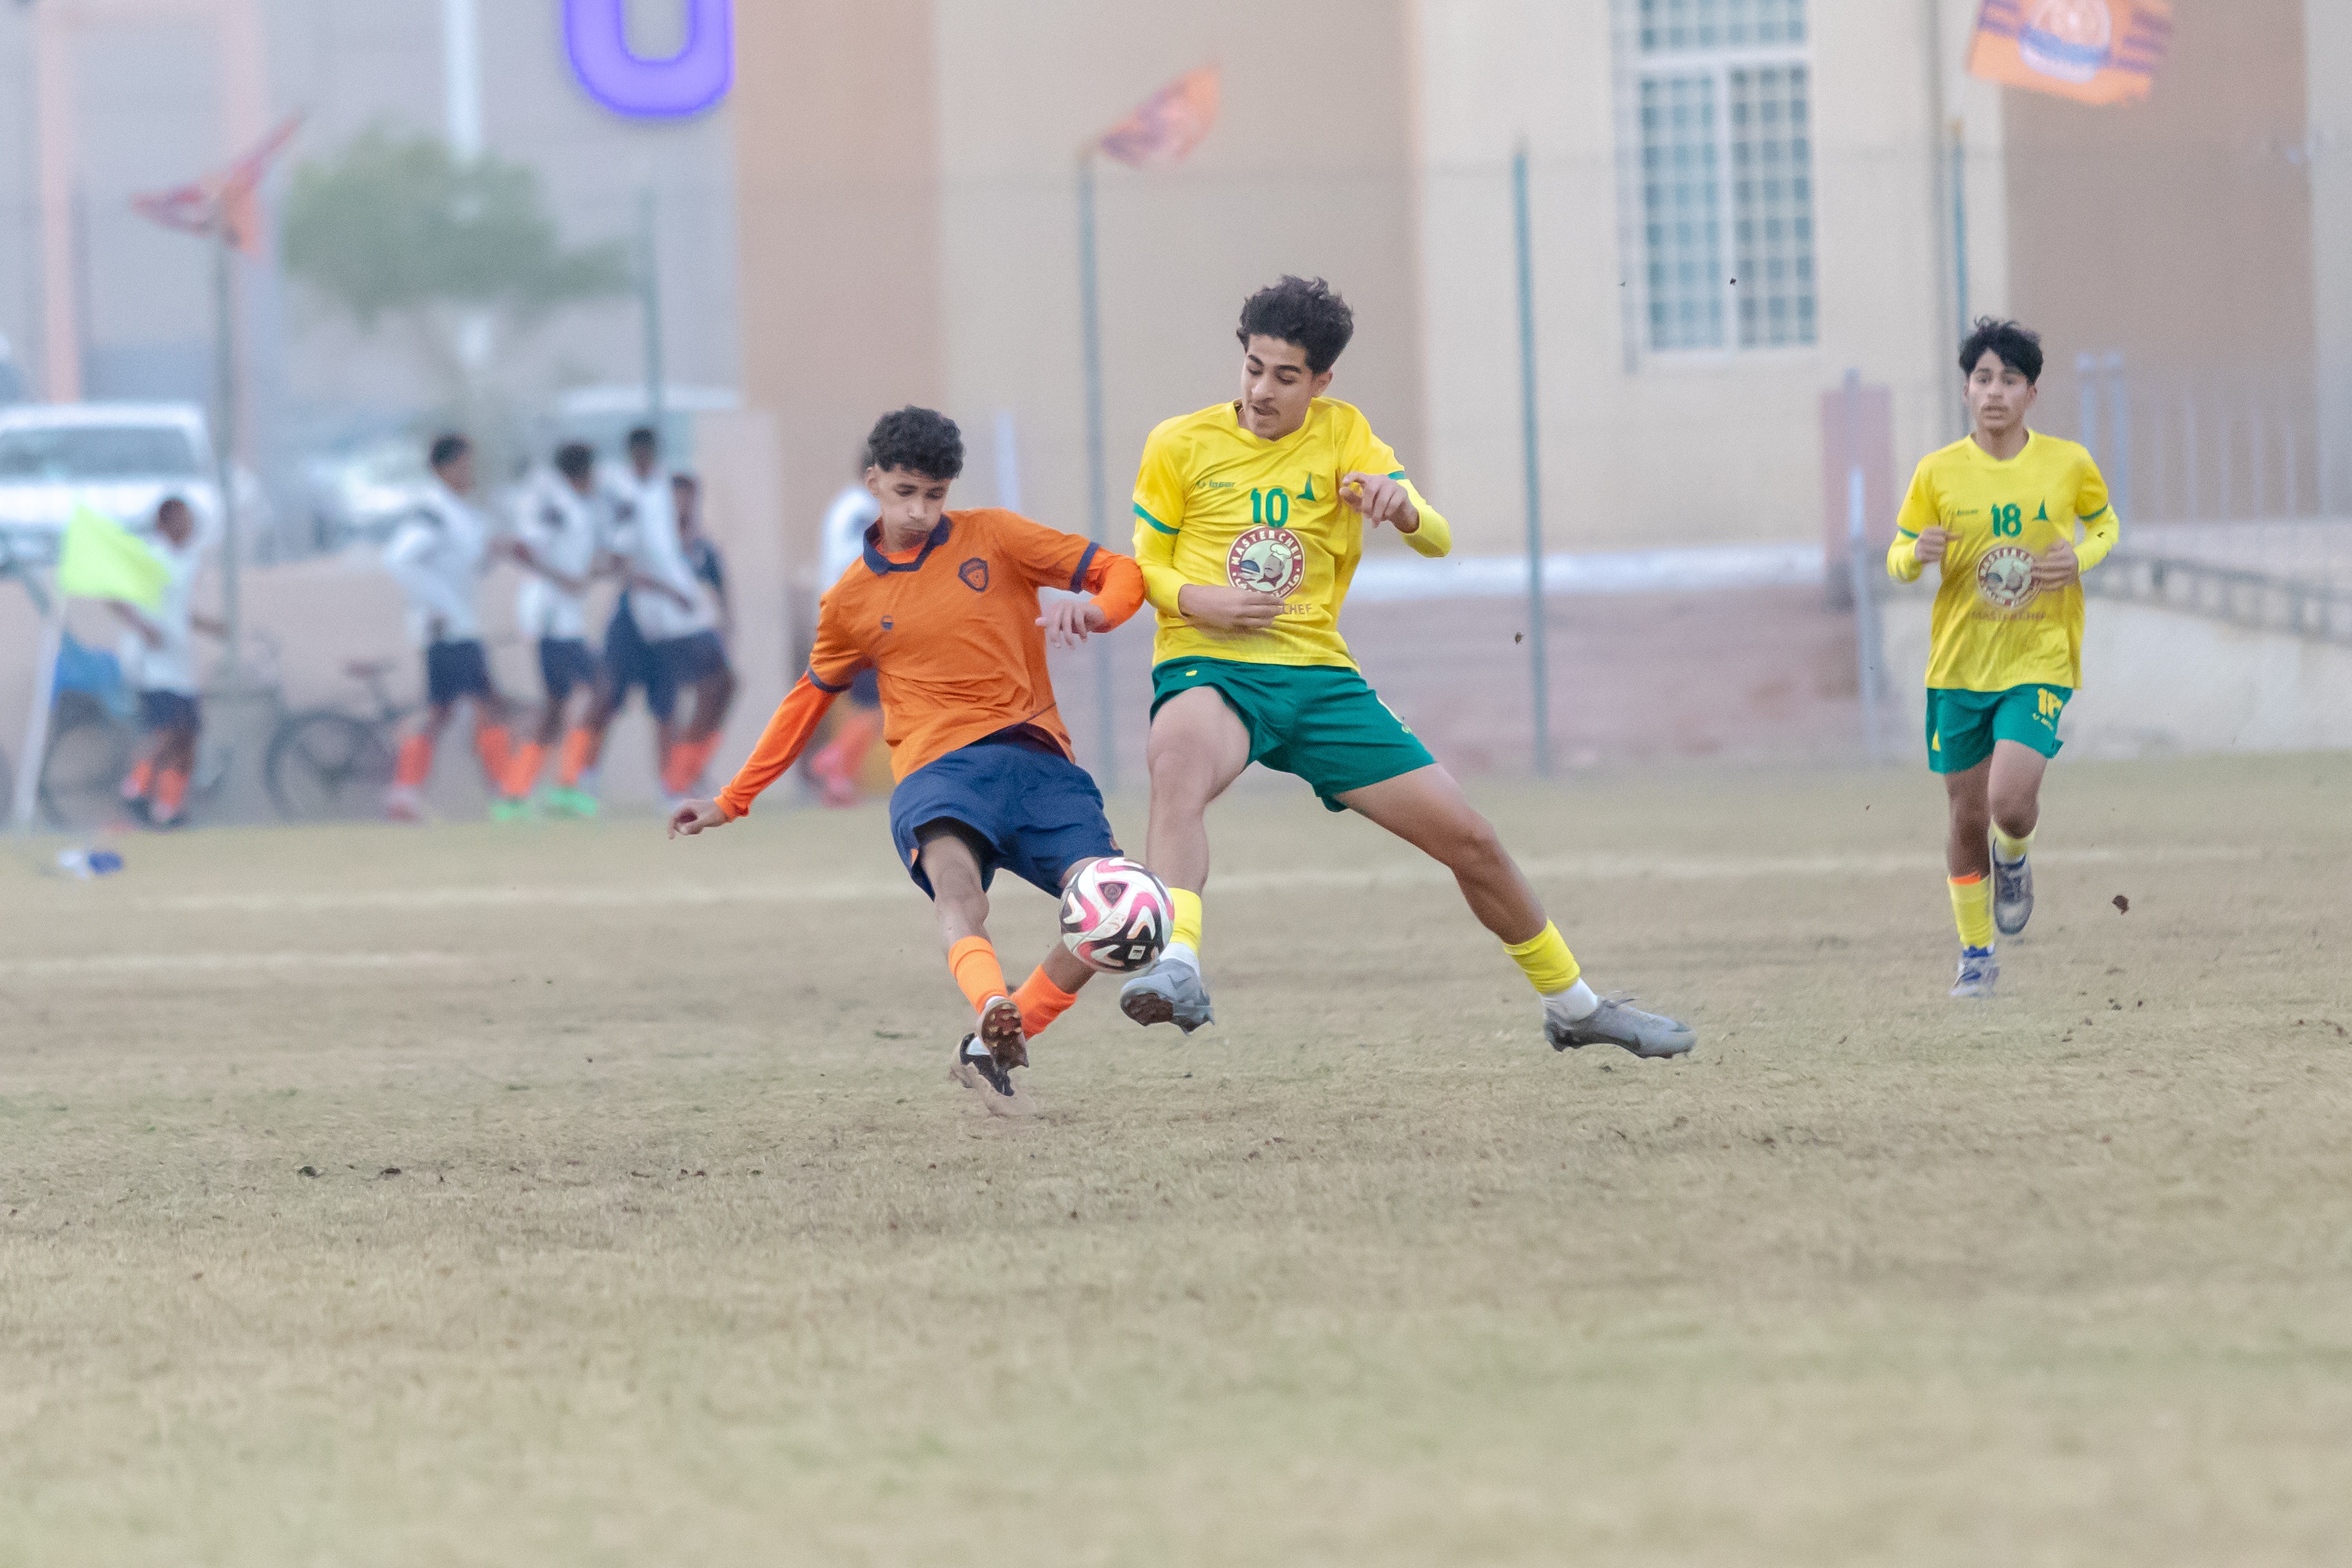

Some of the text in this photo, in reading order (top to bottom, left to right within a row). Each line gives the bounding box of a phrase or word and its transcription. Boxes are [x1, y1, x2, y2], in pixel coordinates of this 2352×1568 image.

[1250, 488, 1289, 529] 10
[1991, 503, 2022, 537] 18
[1230, 530, 1302, 566] MASTERCHEF
